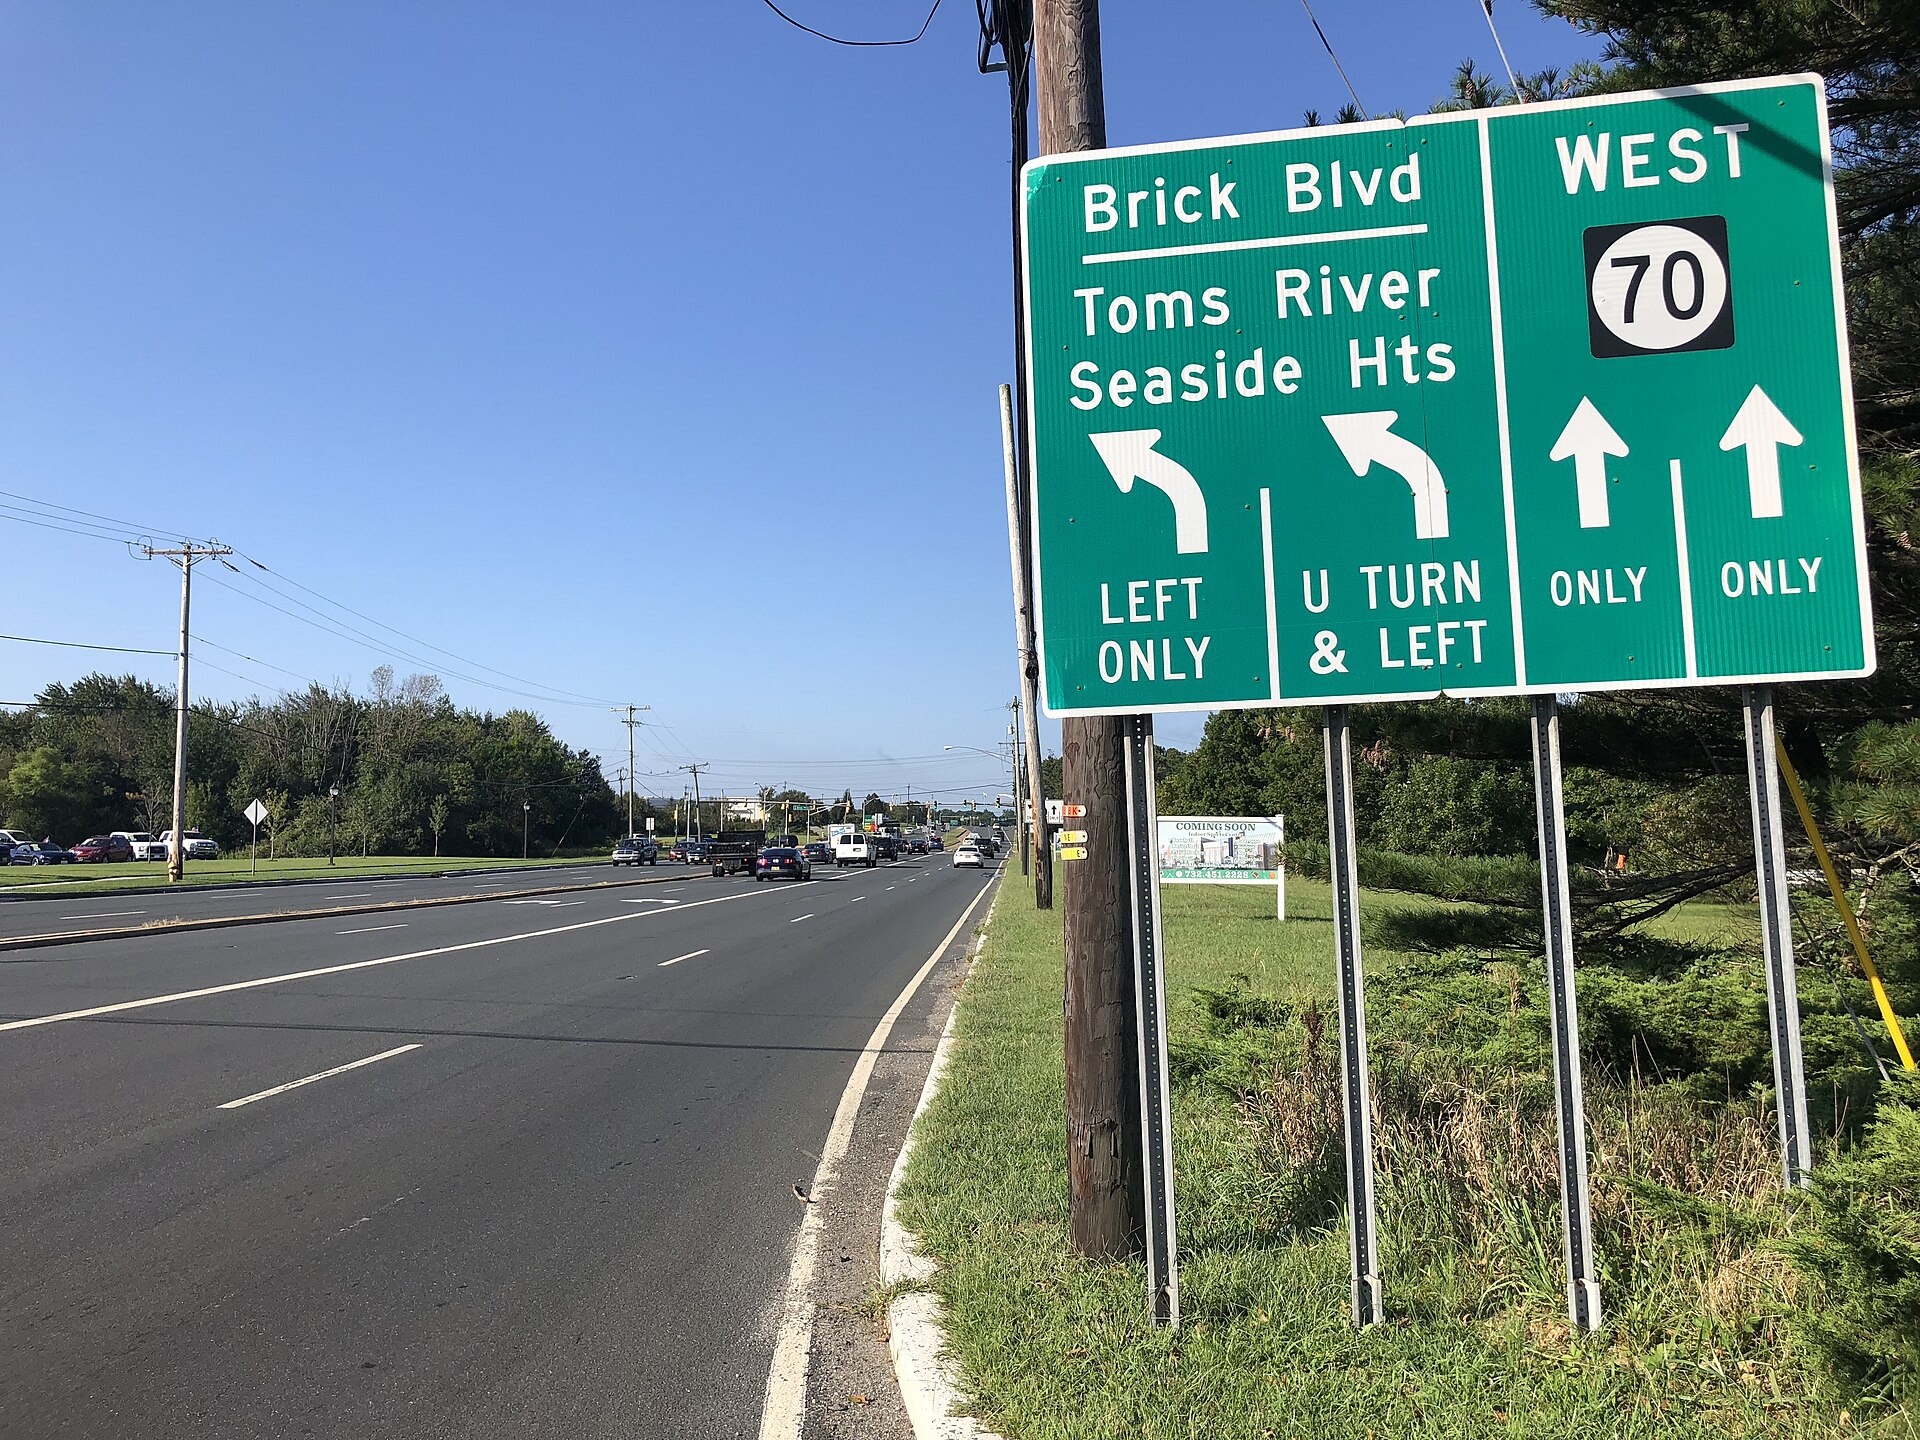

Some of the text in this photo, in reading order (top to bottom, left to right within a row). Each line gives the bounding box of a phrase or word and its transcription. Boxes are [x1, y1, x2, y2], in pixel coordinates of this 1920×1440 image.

[1555, 123, 1749, 195] WEST
[1084, 152, 1421, 233] Brick Blvd
[1074, 265, 1441, 337] Toms River
[1609, 250, 1706, 325] 70
[1069, 336, 1456, 411] Seaside Hts
[1100, 577, 1203, 625] LEFT
[1302, 559, 1481, 614] U TURN
[1550, 566, 1648, 607] ONLY
[1721, 556, 1823, 598] ONLY
[1098, 637, 1211, 684] ONLY
[1309, 619, 1488, 675] & LEFT
[1176, 822, 1256, 831] COMING SOON
[1184, 870, 1249, 879] 732.451.2228
